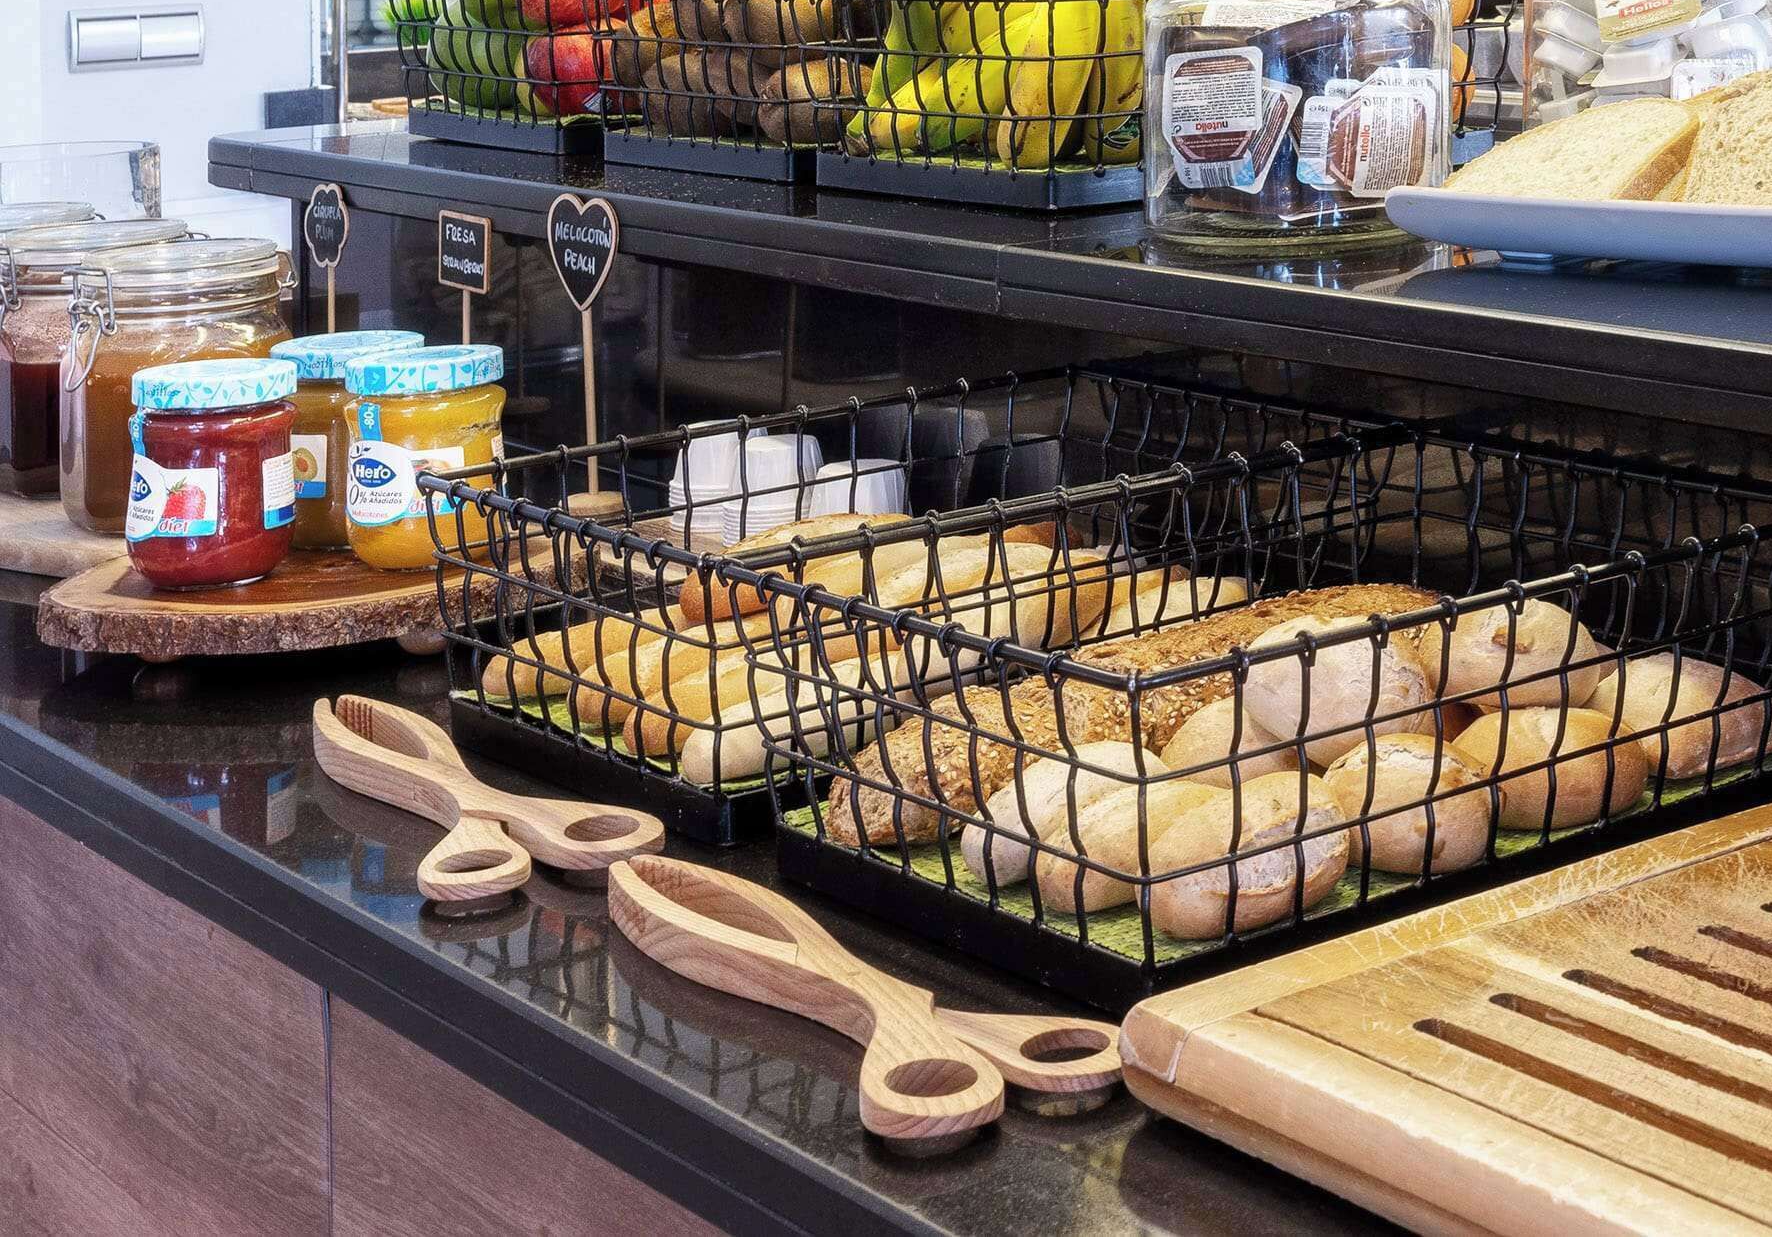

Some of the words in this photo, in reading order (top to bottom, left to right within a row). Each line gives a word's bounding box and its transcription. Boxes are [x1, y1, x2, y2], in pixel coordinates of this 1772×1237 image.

[1195, 120, 1229, 132] nutella
[1358, 124, 1371, 162] nutella
[446, 222, 477, 247] FRESA
[563, 248, 596, 275] PEACH
[354, 465, 392, 479] Hero
